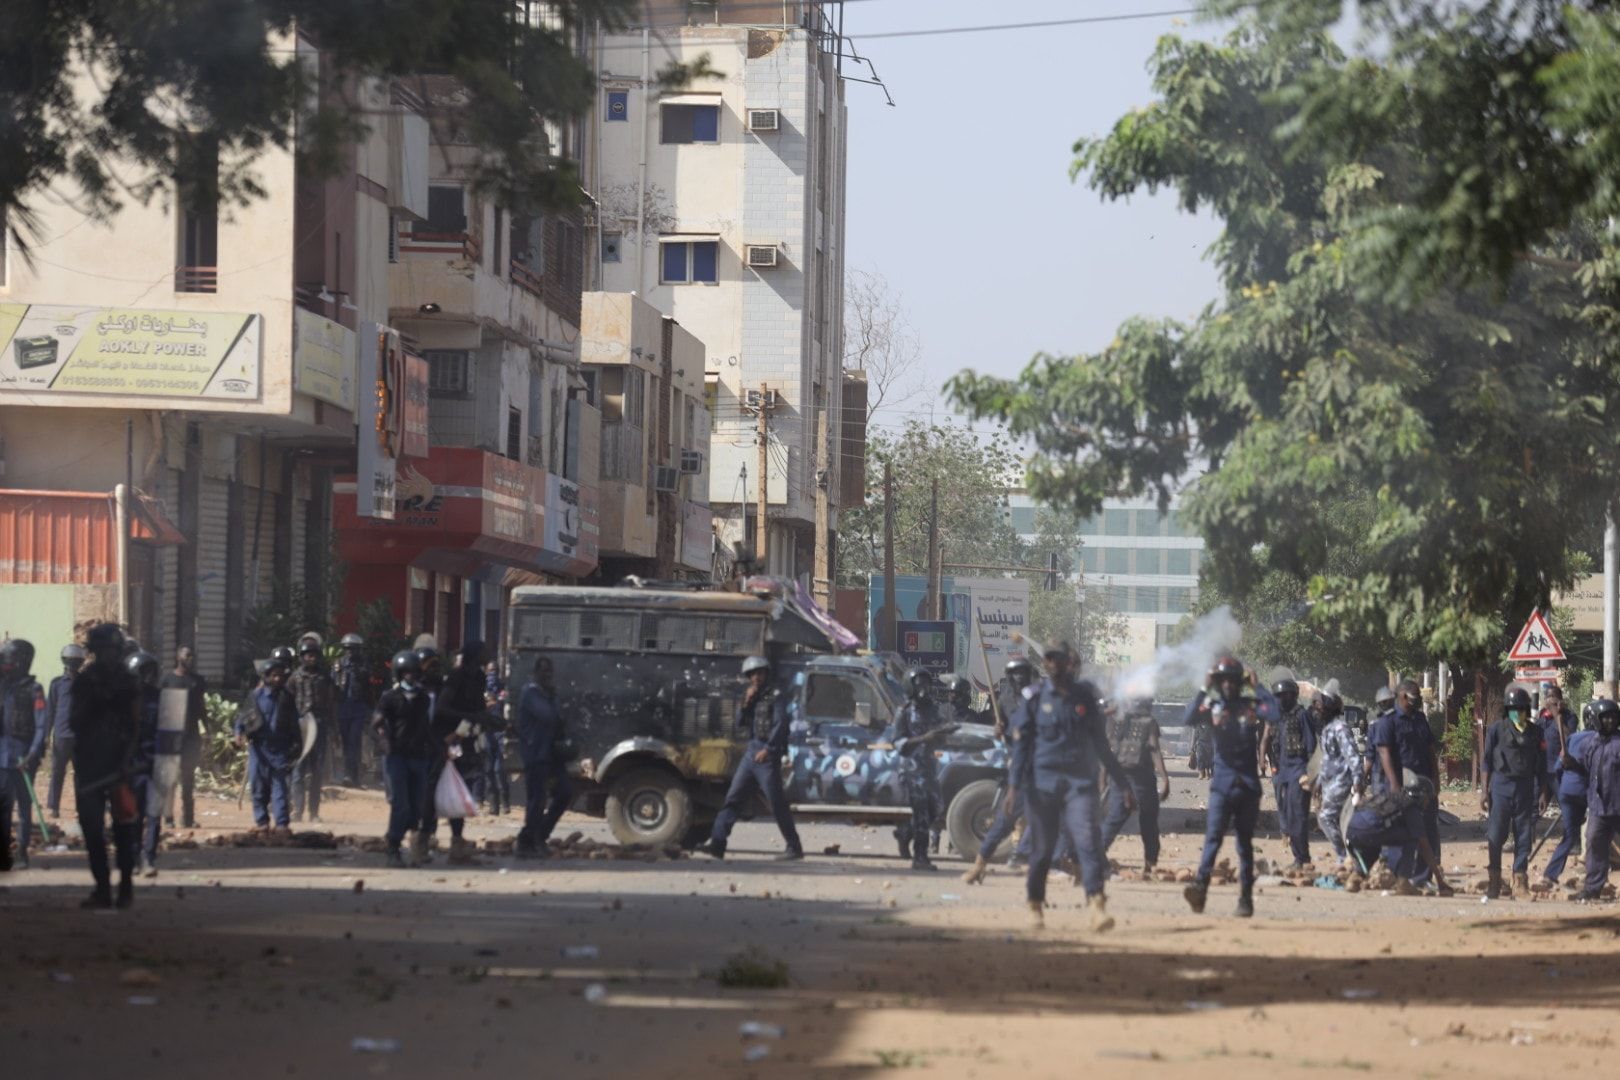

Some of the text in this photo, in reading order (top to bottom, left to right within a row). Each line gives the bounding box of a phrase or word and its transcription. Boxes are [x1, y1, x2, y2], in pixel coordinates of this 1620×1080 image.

[140, 315, 208, 338] بطاريات
[99, 341, 207, 357] AOKLY POWER
